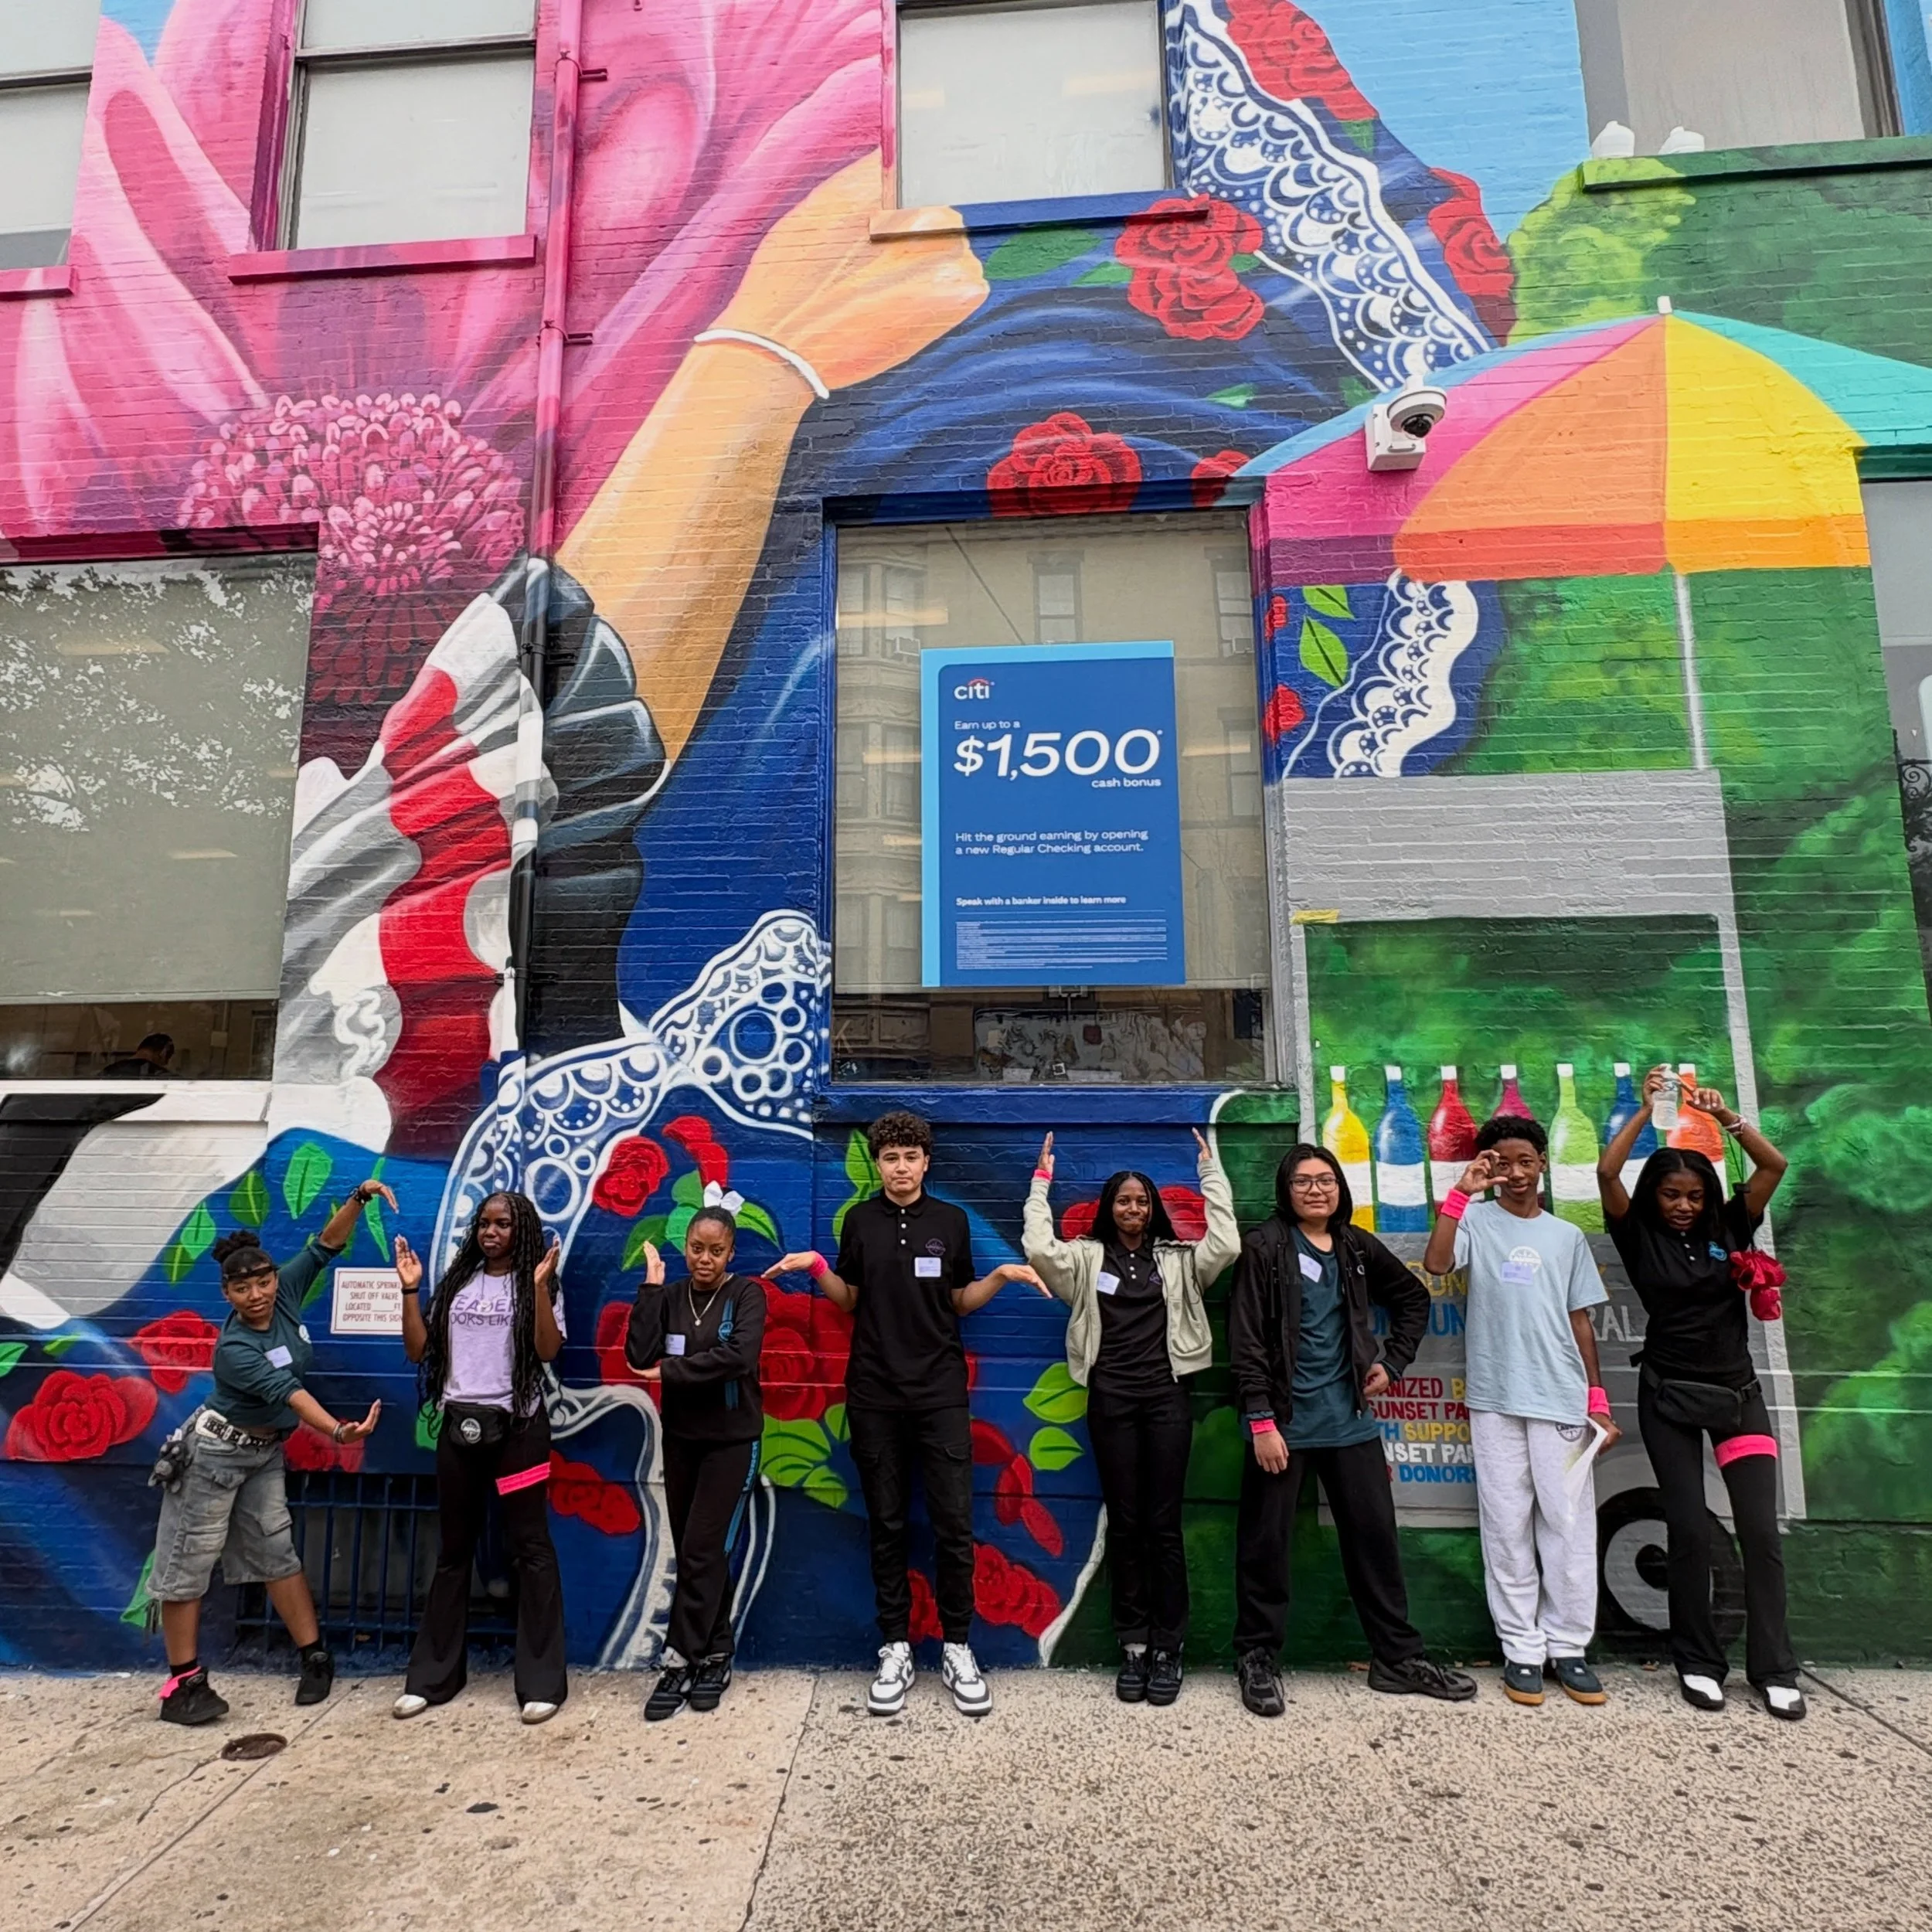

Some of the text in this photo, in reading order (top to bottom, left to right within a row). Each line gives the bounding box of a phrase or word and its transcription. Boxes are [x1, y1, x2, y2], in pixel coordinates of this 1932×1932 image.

[954, 682, 990, 700] citi
[954, 720, 980, 730] Earn
[981, 721, 997, 731] up
[998, 720, 1011, 729] to
[1091, 777, 1162, 788] cash bonus
[955, 829, 1148, 843] Hit the ground earning by opening
[992, 844, 1035, 855] Regular
[1037, 843, 1091, 854] Checking
[1094, 843, 1144, 852] account.
[956, 897, 983, 907] Speak
[984, 896, 1004, 905] with
[1012, 896, 1041, 905] banker
[1080, 896, 1102, 904] learn
[350, 1291, 366, 1300] SHUT
